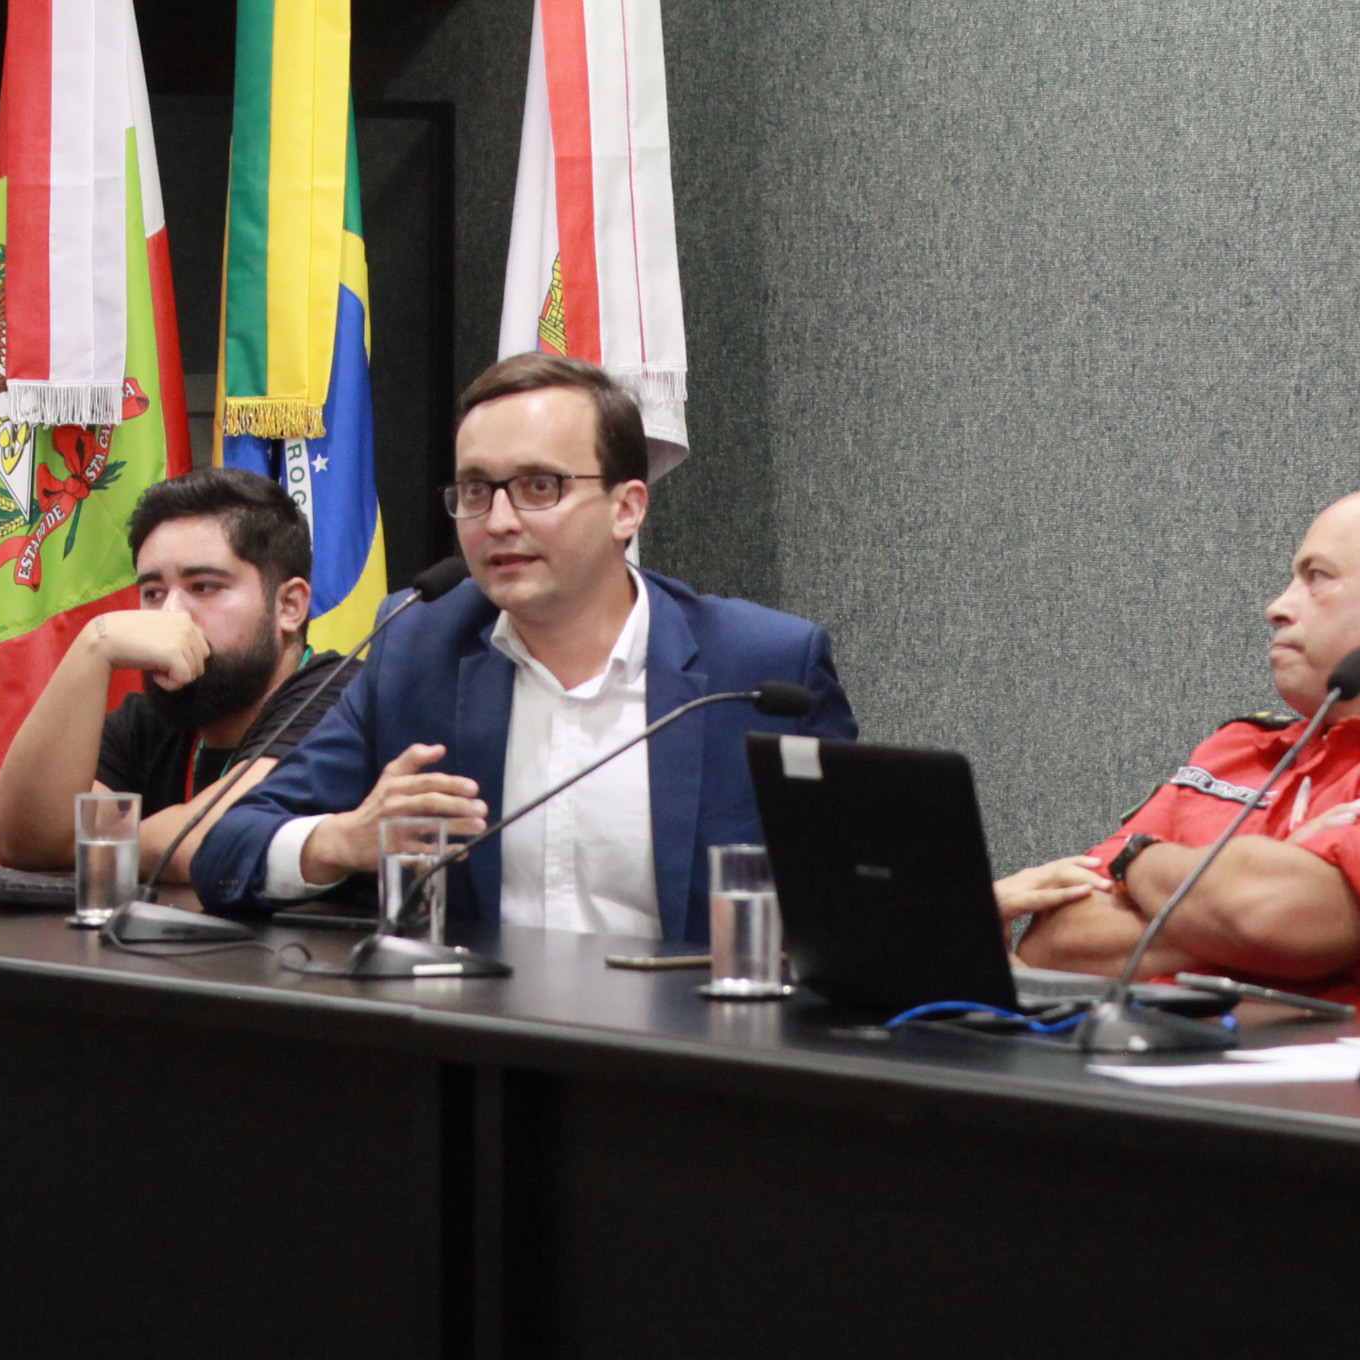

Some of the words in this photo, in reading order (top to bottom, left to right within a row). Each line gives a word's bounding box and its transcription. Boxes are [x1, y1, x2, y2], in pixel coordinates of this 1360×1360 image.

[17, 521, 46, 580] ESTADO
[45, 504, 66, 528] DE
[85, 452, 106, 482] STA.
[287, 443, 307, 510] ROG
